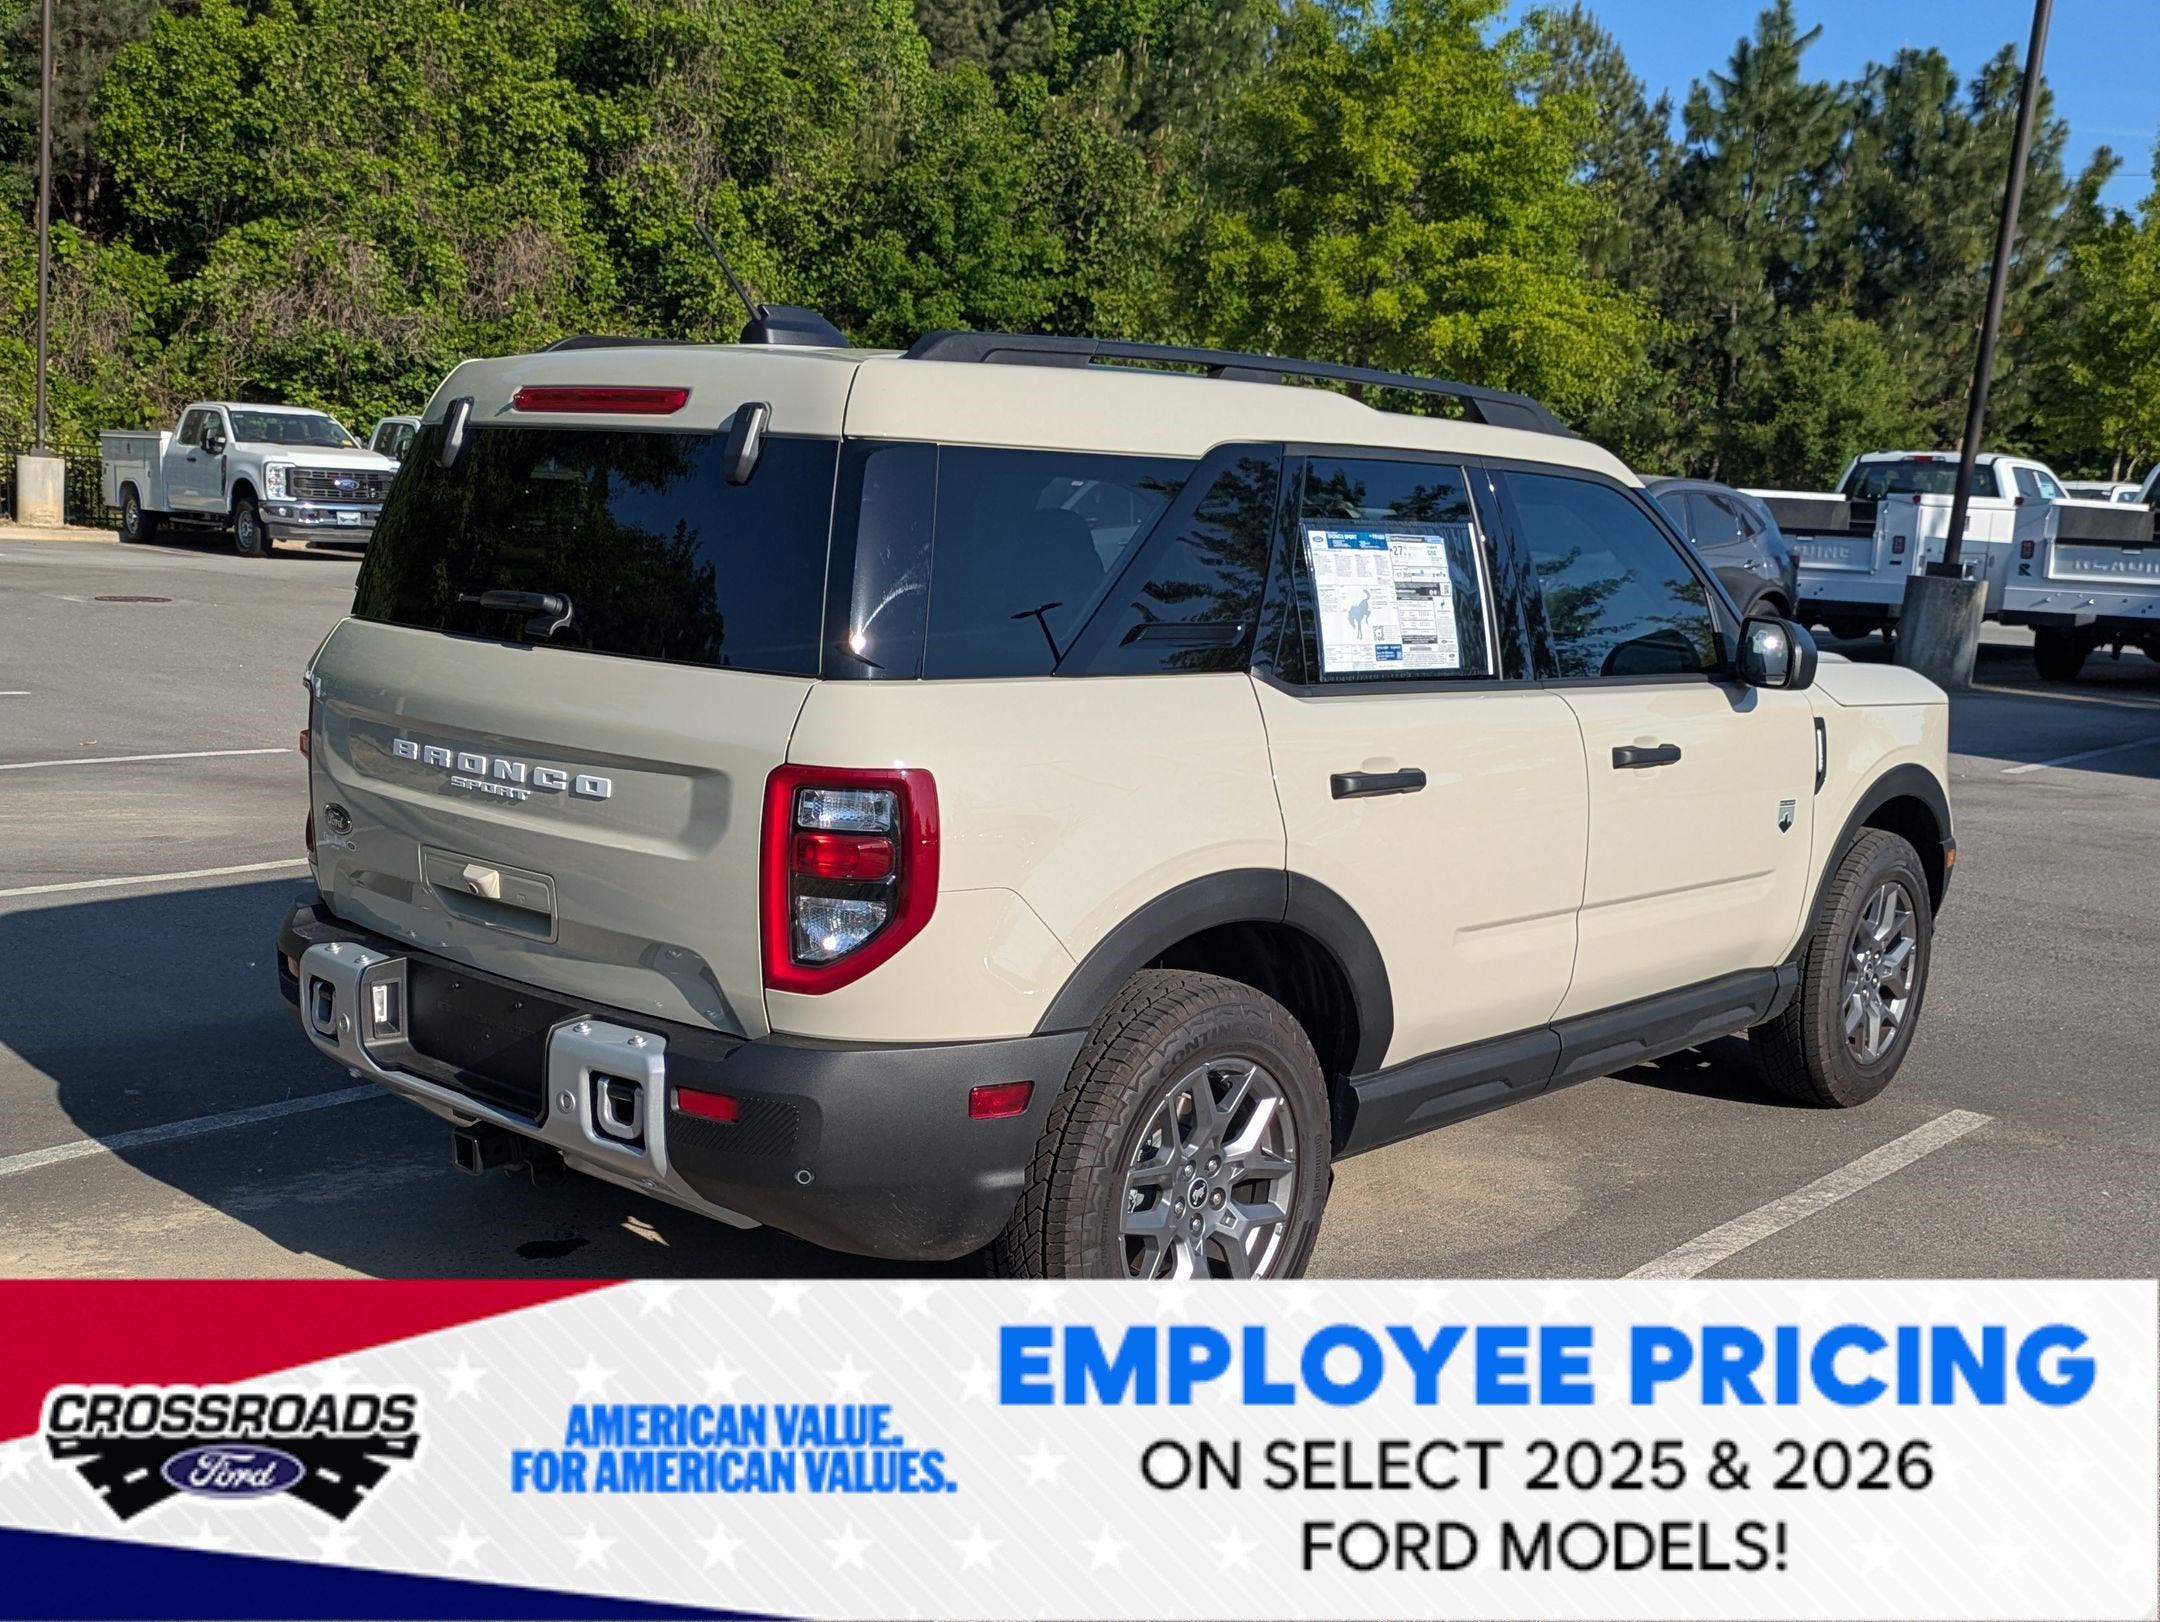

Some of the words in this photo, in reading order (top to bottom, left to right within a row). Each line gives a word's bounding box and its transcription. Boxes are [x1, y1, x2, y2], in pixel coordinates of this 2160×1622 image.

[1392, 545, 1403, 556] 27
[393, 738, 613, 799] BRONCO
[450, 775, 532, 801] SPORT
